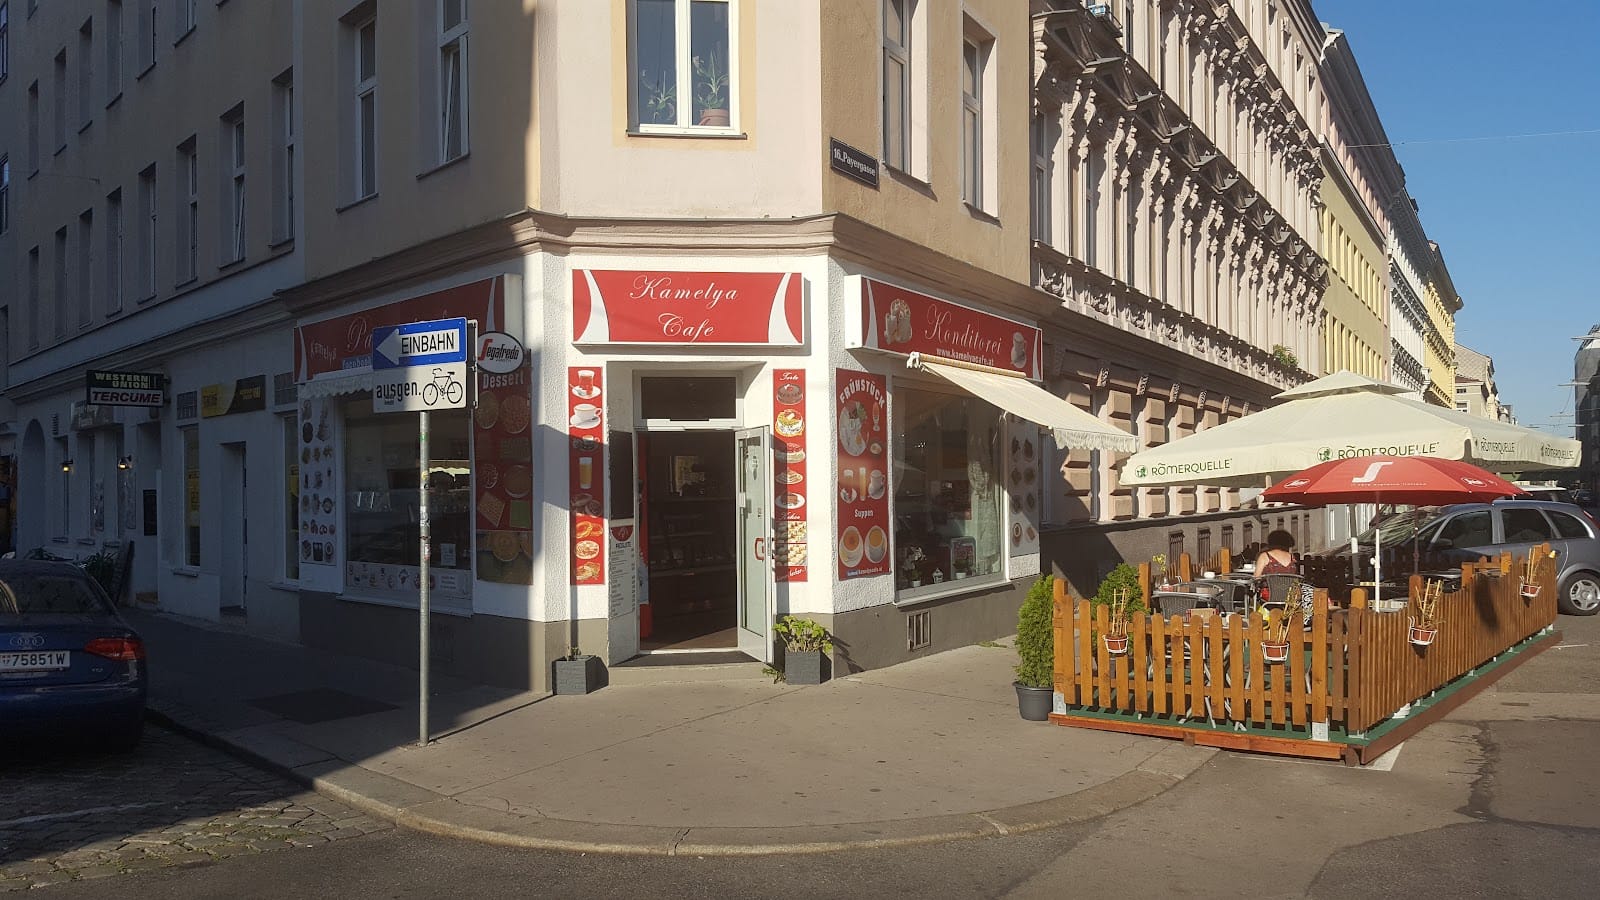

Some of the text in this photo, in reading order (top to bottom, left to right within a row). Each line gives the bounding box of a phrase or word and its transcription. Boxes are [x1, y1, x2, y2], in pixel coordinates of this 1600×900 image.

[842, 151, 876, 176] Payergasse
[629, 275, 739, 309] Kamelya
[658, 312, 716, 343] Cafe
[925, 303, 1002, 354] Konditorei
[401, 332, 455, 355] EINBAHN
[478, 338, 520, 361] Segafredo
[936, 348, 994, 366] www.kamelyacafe.at
[95, 372, 148, 382] WESTERN
[112, 381, 149, 389] UNION
[482, 368, 524, 389] Dessert
[376, 382, 421, 402] ausgen.
[840, 378, 885, 409] FRÜHSTÜCK
[854, 508, 874, 519] Suppen
